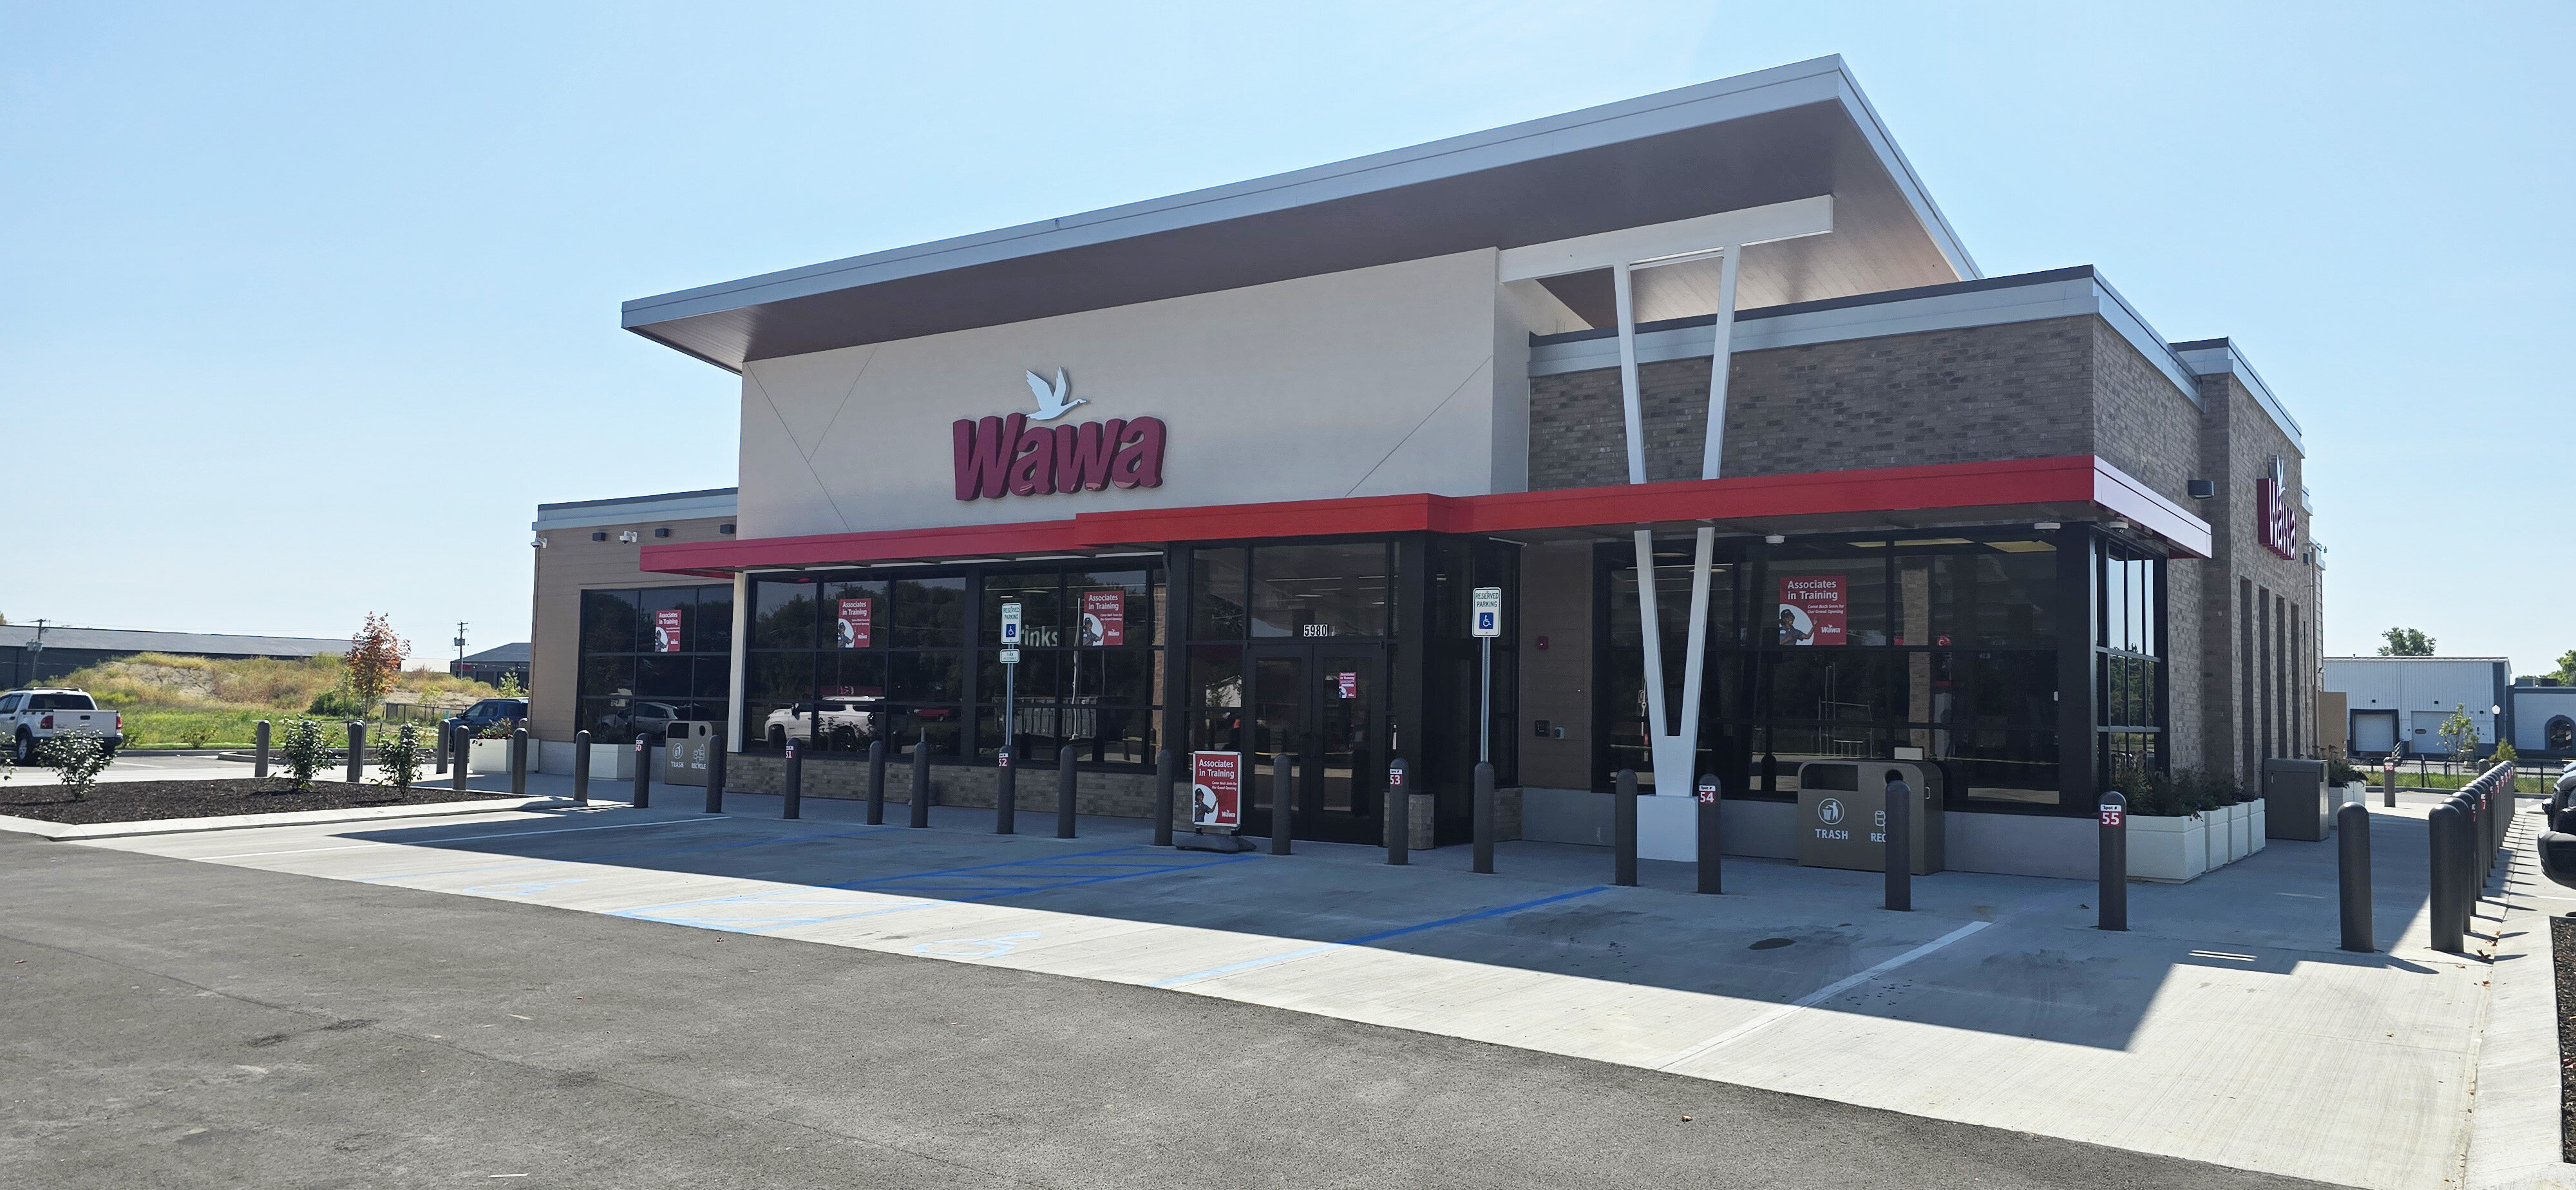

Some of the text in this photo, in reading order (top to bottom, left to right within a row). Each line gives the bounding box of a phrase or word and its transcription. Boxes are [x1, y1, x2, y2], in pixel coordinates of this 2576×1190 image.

[953, 413, 1166, 500] Wawa
[2264, 477, 2297, 560] Wawa
[1788, 580, 1837, 589] Associates
[1788, 590, 1837, 601] in Training
[1096, 603, 1119, 611] Training
[1305, 625, 1327, 636] 5980
[999, 758, 1007, 766] 52
[1198, 759, 1234, 768] Associates
[1199, 768, 1235, 779] in Training
[1390, 775, 1401, 785] 53
[1700, 792, 1714, 802] 54
[2102, 812, 2119, 825] 55
[1815, 828, 1848, 840] TRASH
